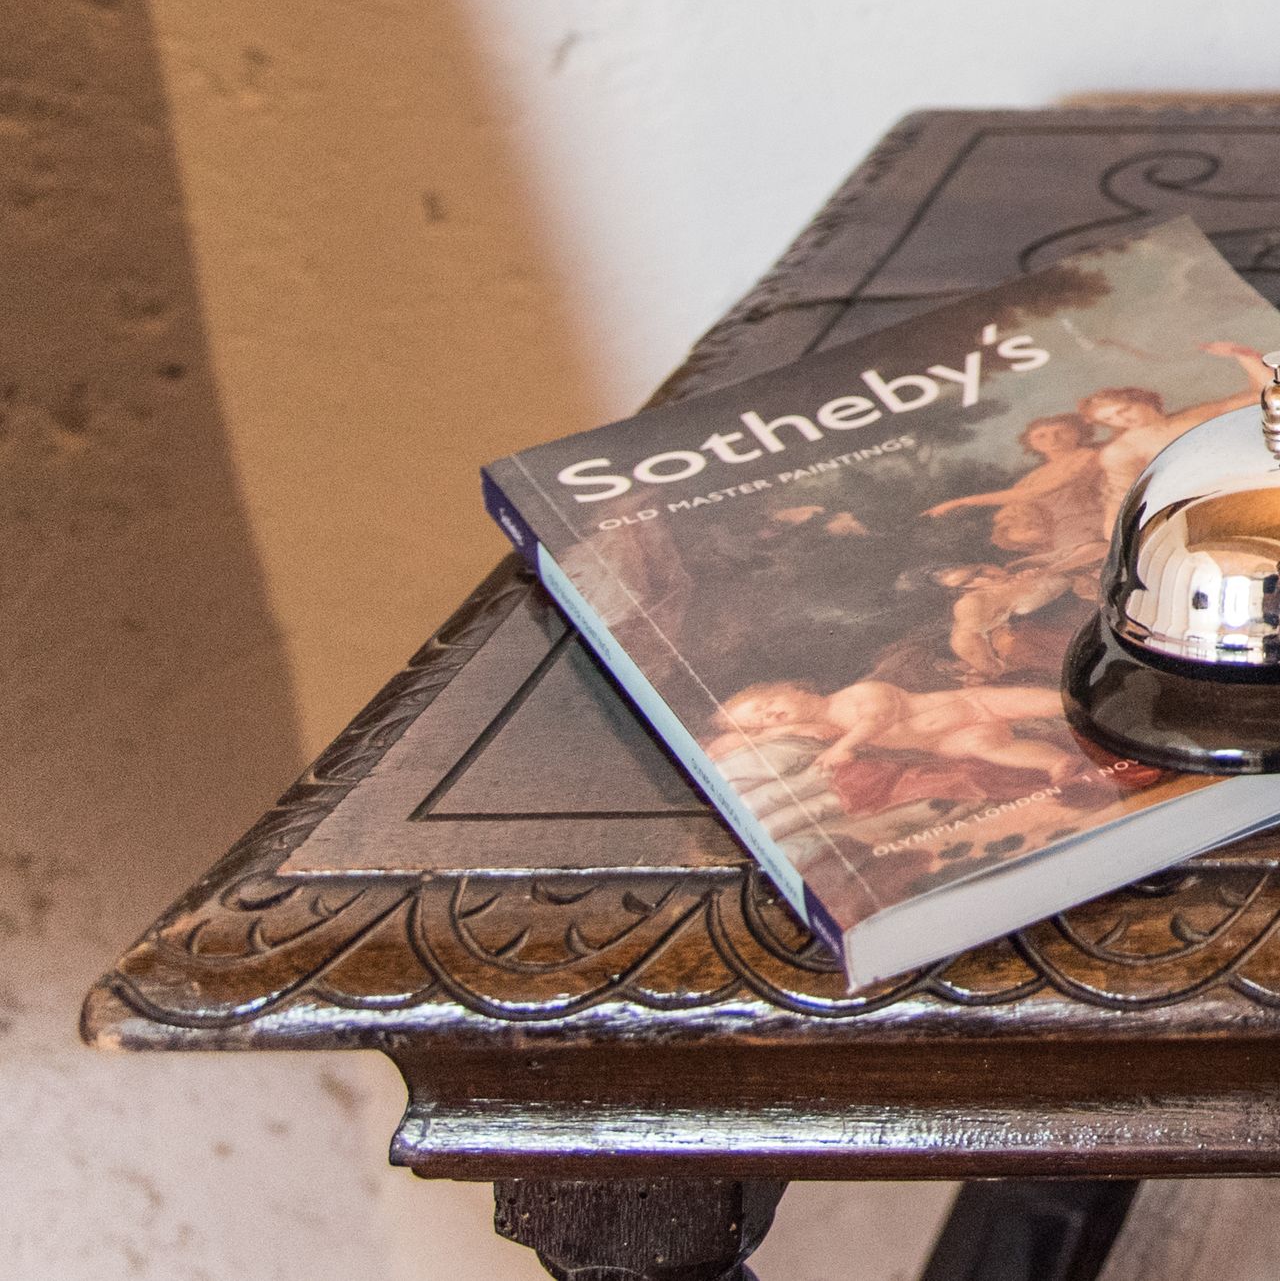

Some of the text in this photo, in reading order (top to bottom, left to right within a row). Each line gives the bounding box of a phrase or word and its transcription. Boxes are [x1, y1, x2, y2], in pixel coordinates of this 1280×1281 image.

[557, 324, 1050, 503] Sotheby's
[598, 434, 916, 531] OLD MASTER PAINTINGS
[872, 819, 969, 858] OLYMPIA
[973, 785, 1062, 823] LONDON
